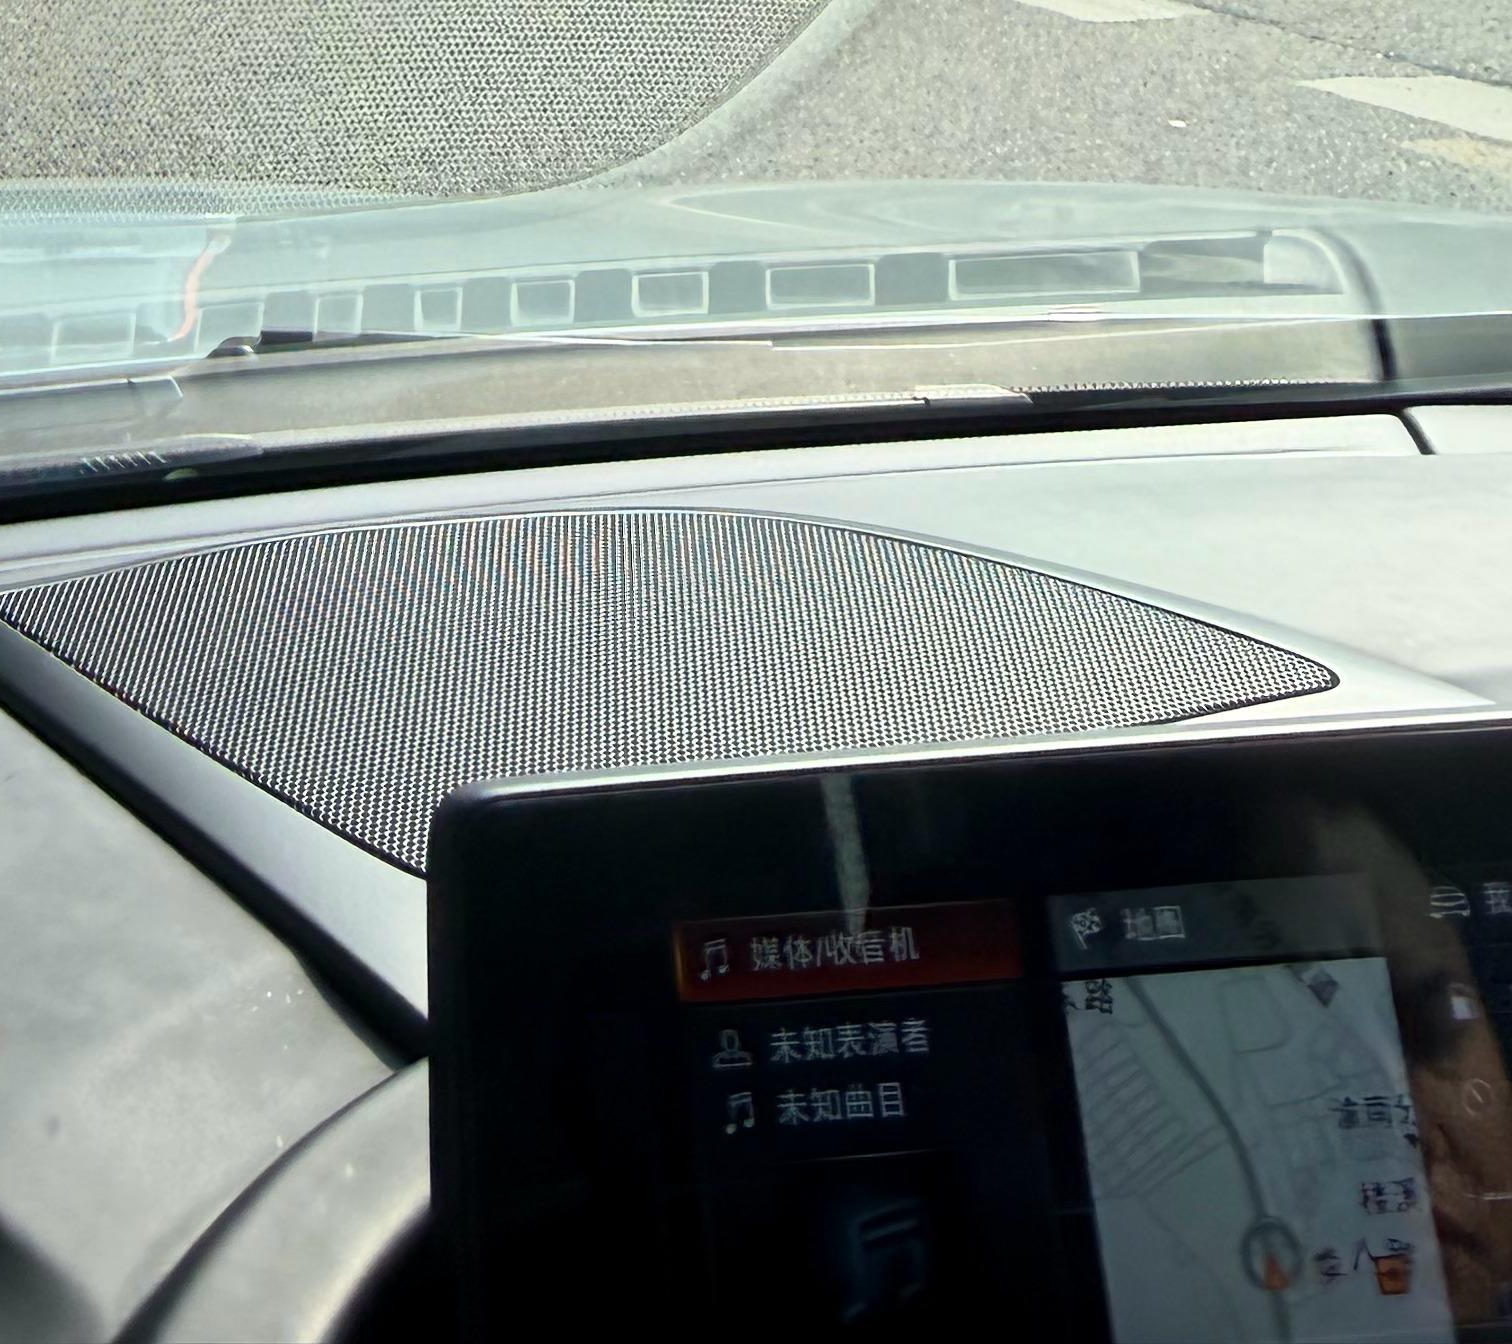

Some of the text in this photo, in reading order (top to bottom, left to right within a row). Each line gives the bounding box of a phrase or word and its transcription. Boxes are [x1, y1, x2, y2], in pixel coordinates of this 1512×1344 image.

[769, 1017, 931, 1063] 未知表演者
[776, 1082, 905, 1126] 未知曲目
